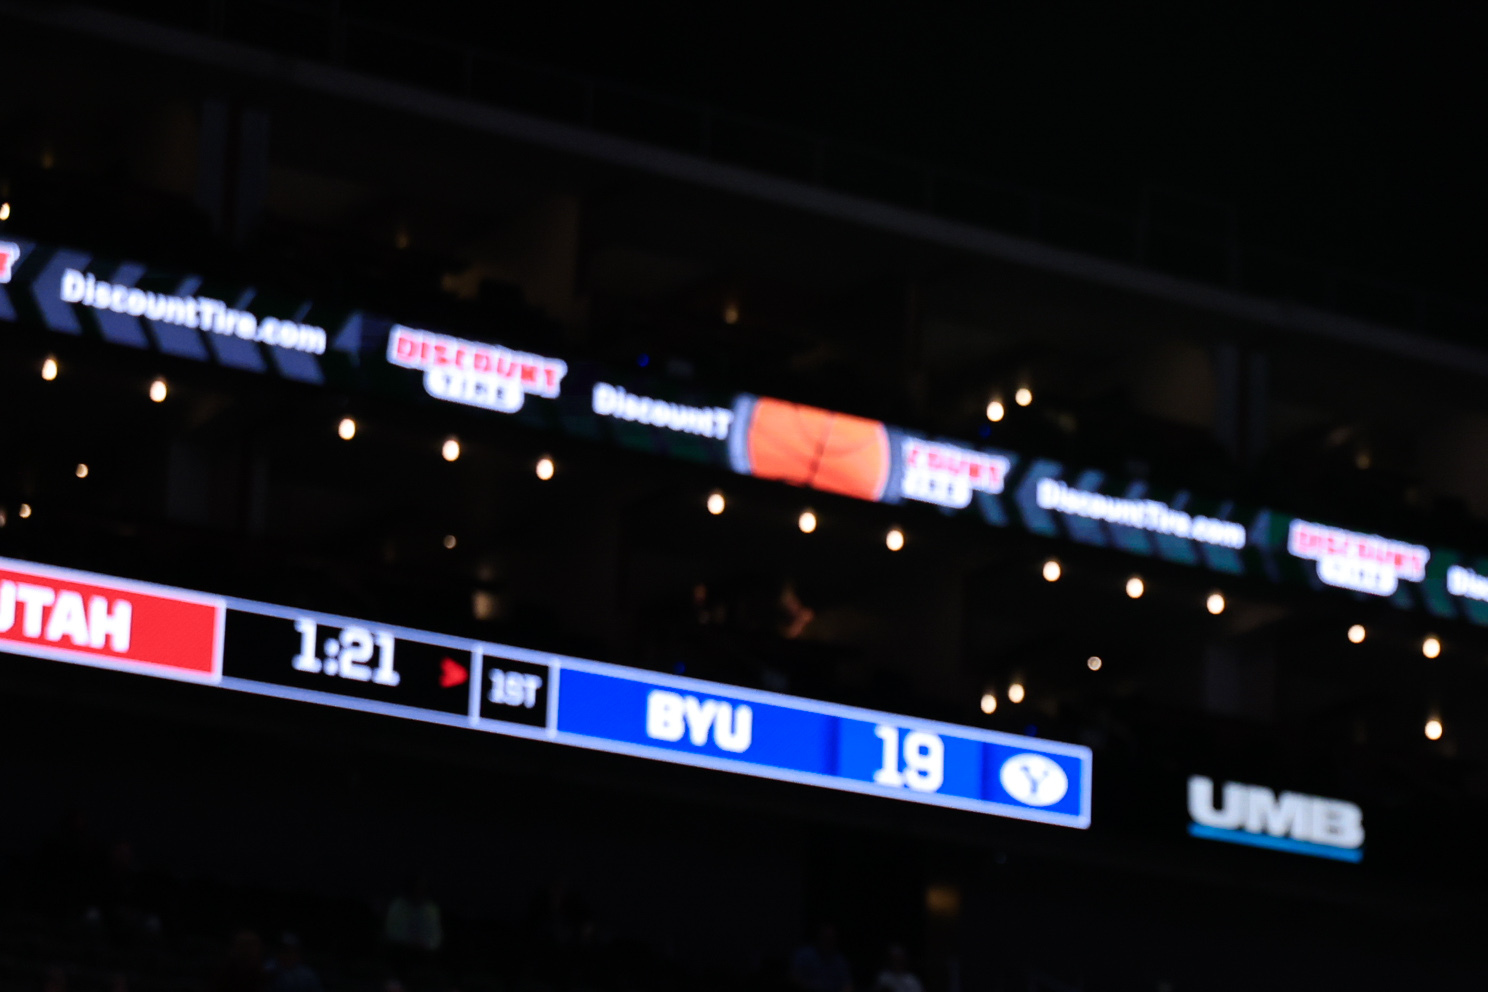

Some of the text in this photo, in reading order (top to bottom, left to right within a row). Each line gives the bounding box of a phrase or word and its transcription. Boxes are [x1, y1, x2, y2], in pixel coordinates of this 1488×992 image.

[60, 268, 328, 356] DiscountTire.com
[291, 617, 401, 687] 1:21
[486, 666, 543, 708] 1ST
[646, 690, 753, 753] BYU
[872, 723, 945, 793] 19
[1187, 774, 1364, 850] UMB
